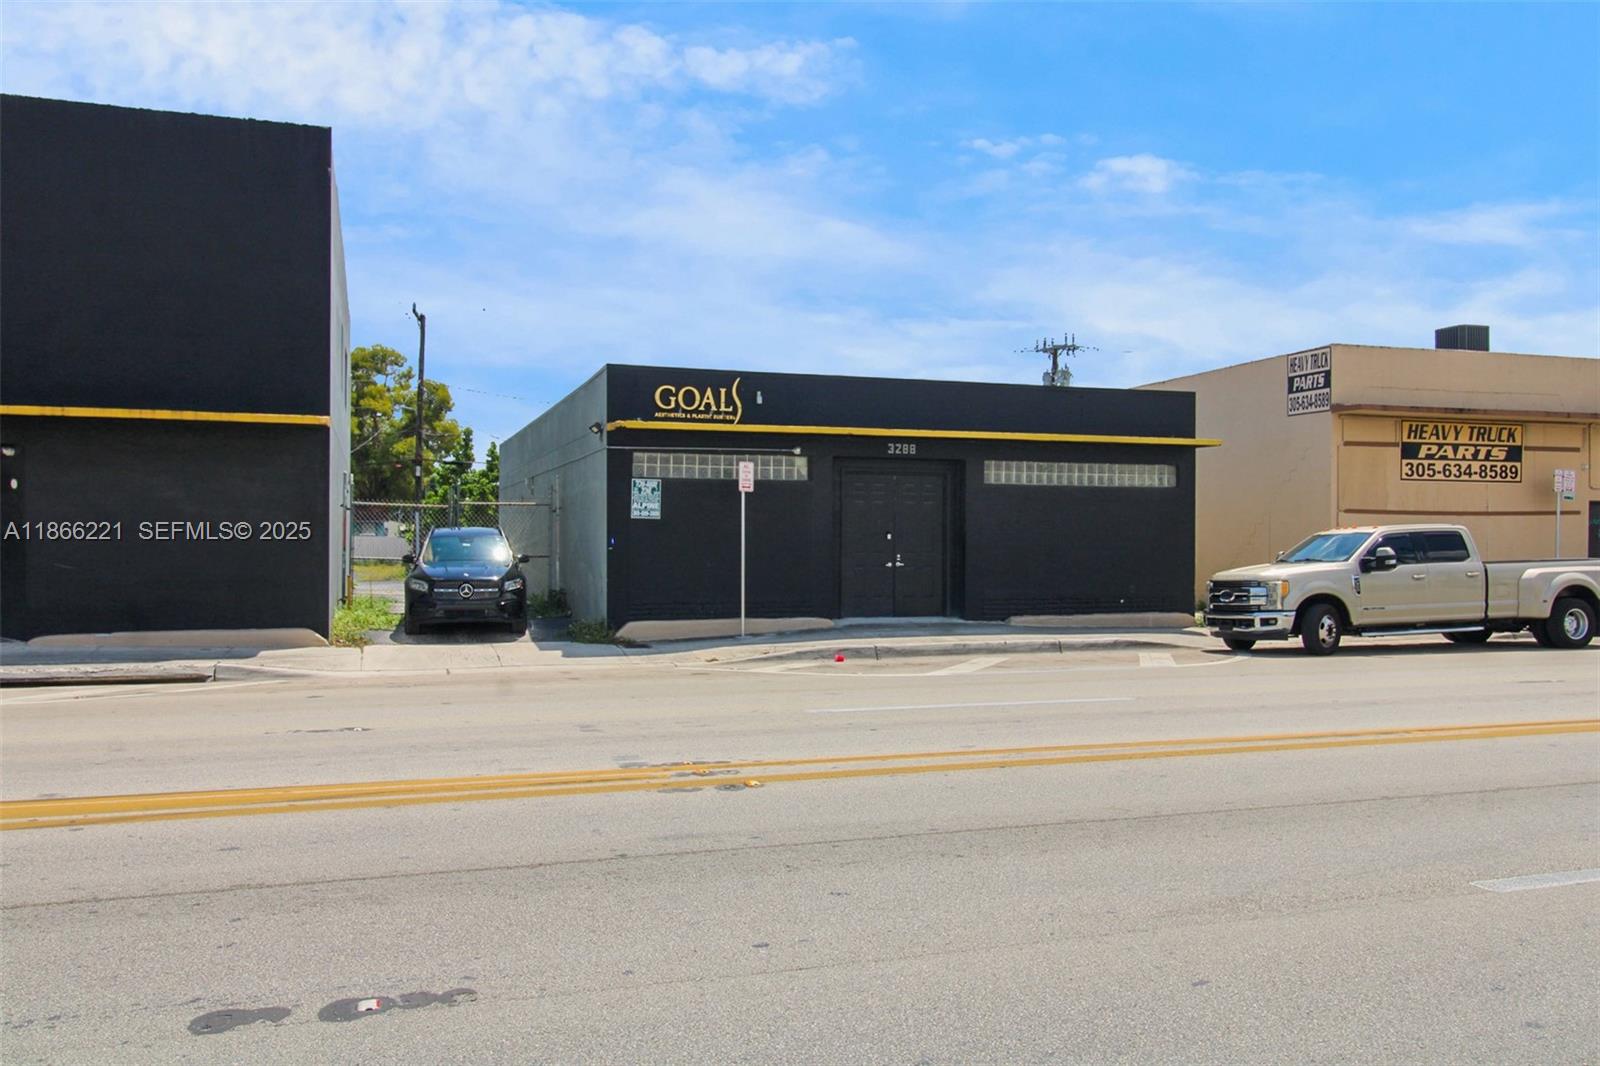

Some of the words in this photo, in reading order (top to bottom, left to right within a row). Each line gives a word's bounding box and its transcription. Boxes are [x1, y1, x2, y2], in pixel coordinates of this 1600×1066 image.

[1292, 373, 1325, 391] PARTS
[654, 377, 742, 424] GOALS
[1407, 423, 1464, 441] HEAVY
[1468, 425, 1518, 443] TRUCK
[888, 443, 916, 454] 3288
[1418, 444, 1509, 460] PARTS
[1404, 462, 1519, 480] 305-634-8589
